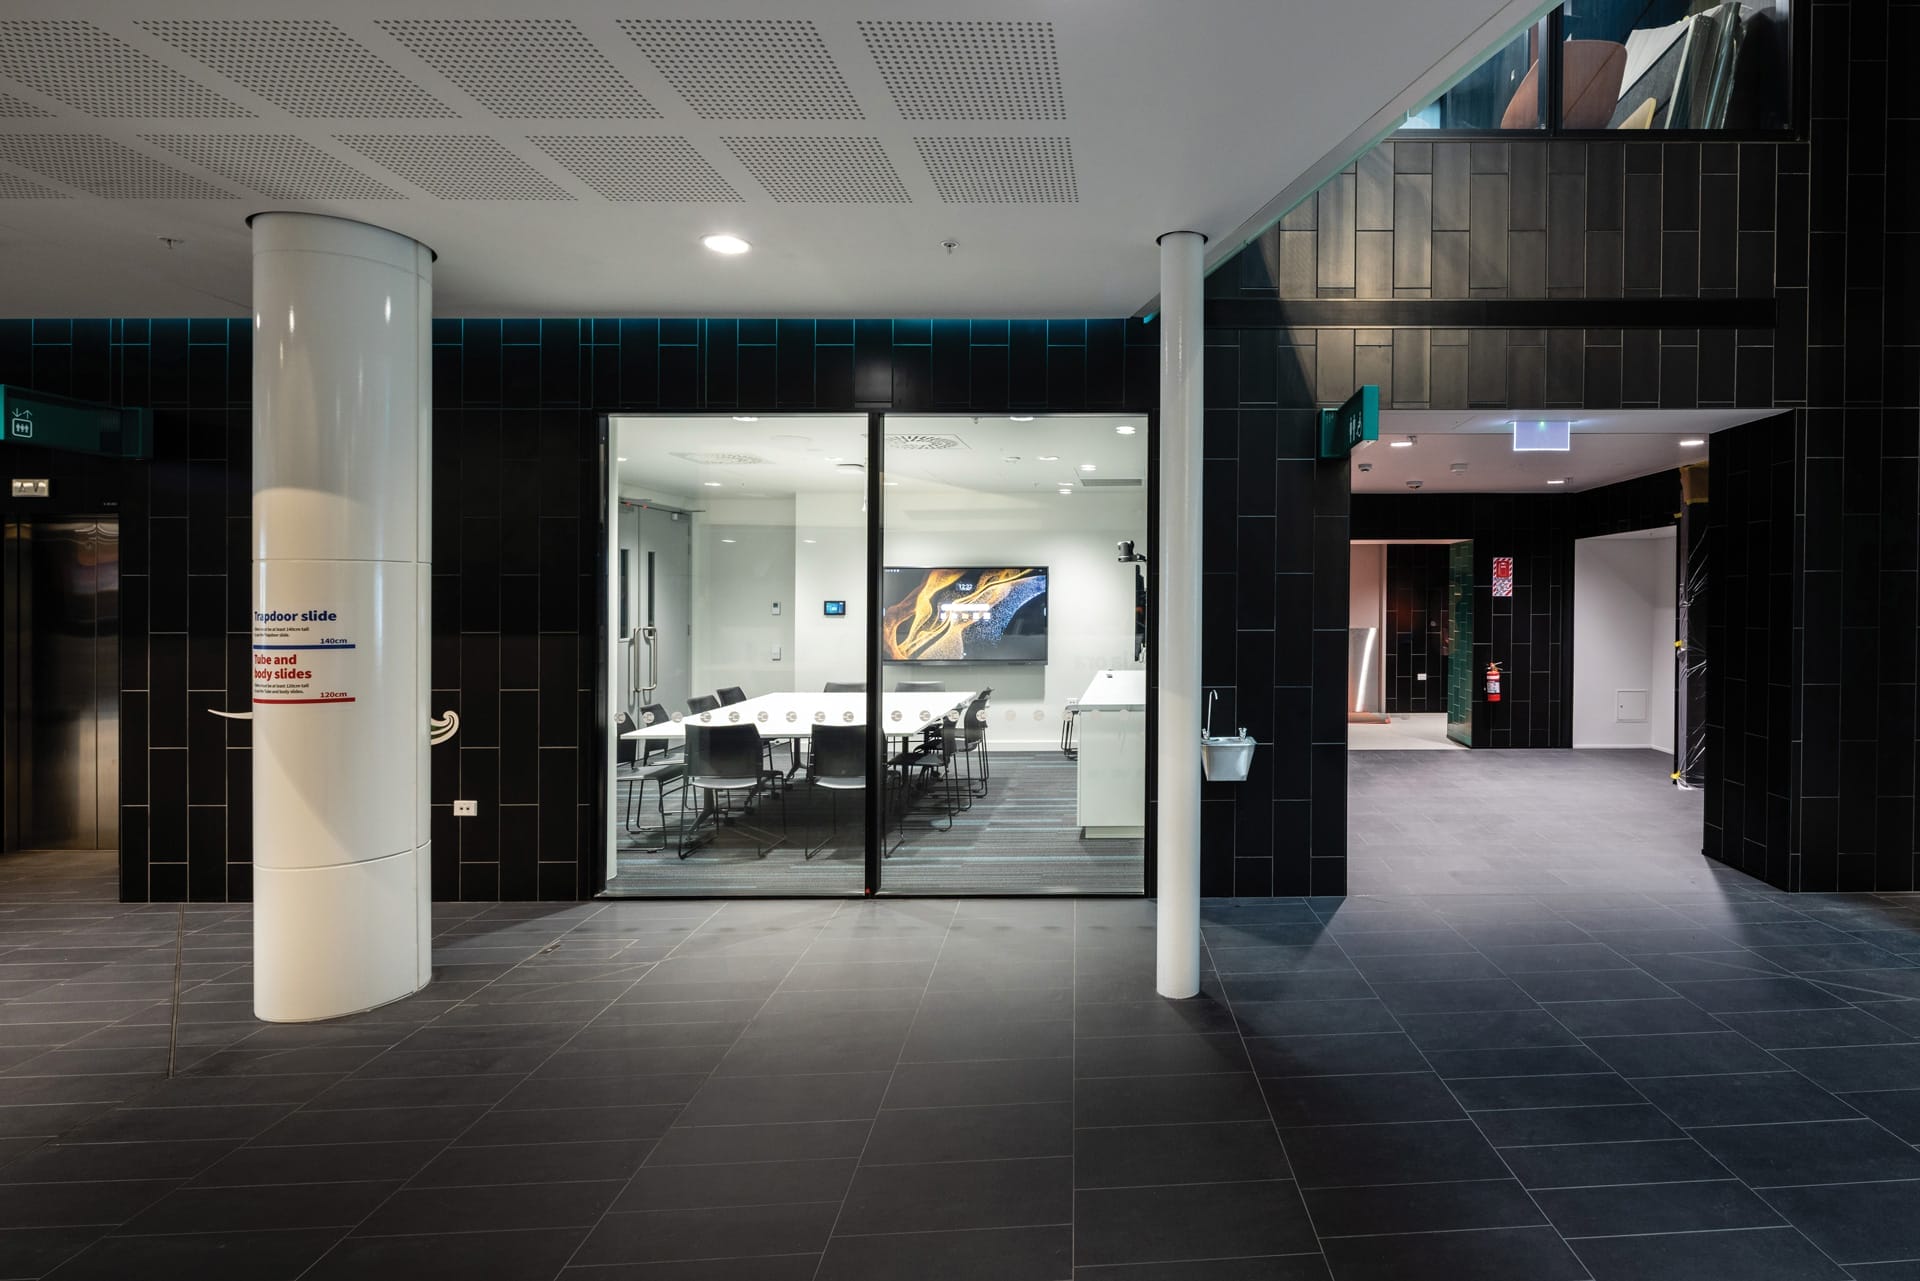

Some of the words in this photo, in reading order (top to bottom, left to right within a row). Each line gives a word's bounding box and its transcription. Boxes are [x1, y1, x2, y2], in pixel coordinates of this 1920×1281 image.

[254, 610, 298, 624] Trapdoor
[301, 610, 337, 621] slide
[254, 654, 271, 664] Tube
[274, 654, 297, 665] and
[254, 669, 272, 681] body
[275, 668, 312, 679] slides
